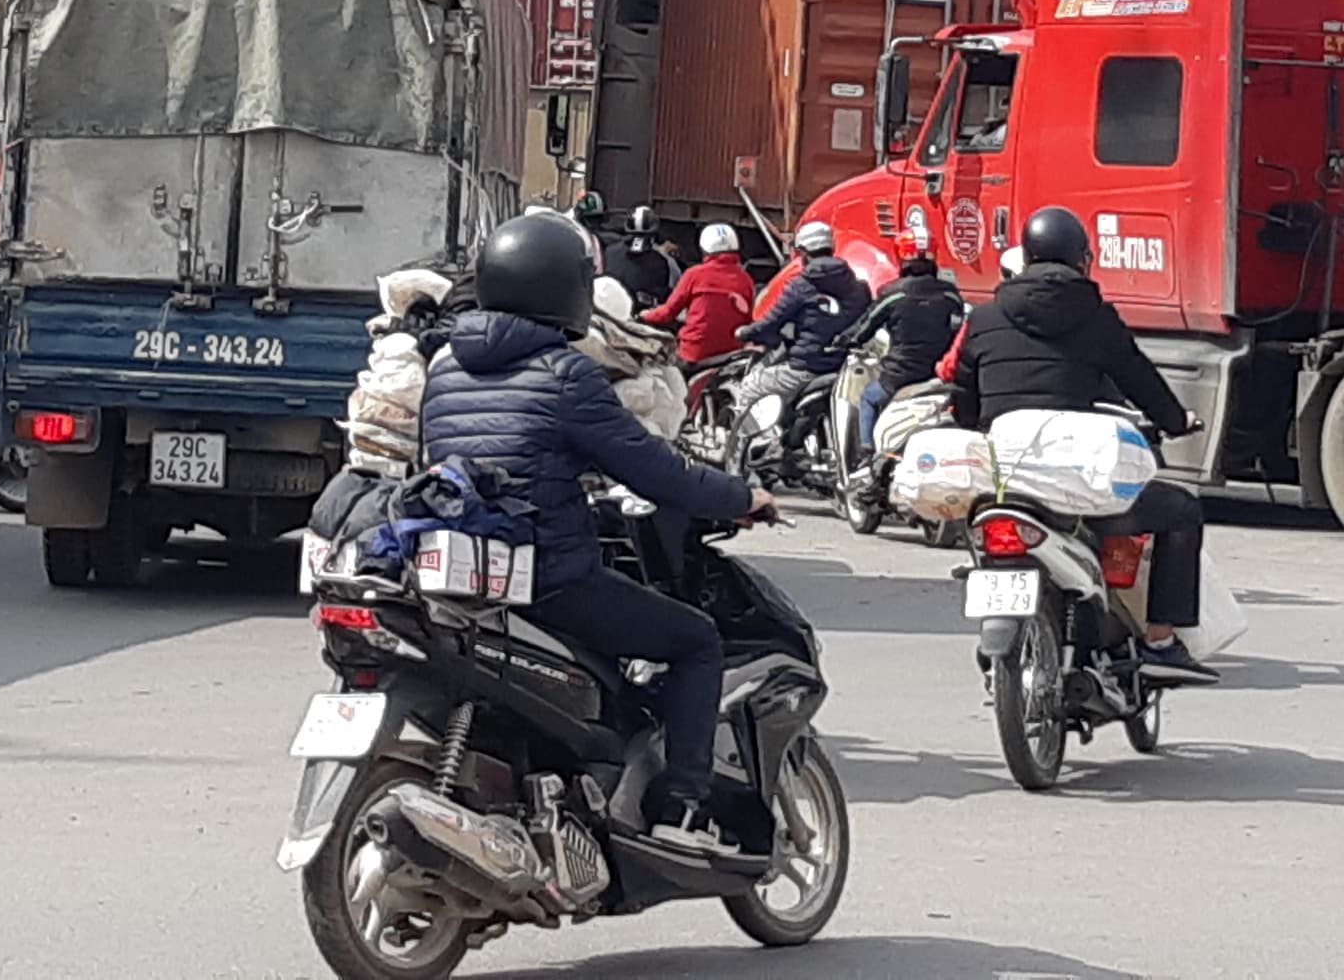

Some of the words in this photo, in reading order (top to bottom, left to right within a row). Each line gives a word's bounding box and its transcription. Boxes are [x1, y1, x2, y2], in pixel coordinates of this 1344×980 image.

[133, 330, 180, 359] 29C
[203, 334, 284, 366] 343.24
[169, 436, 207, 459] 29C
[153, 459, 220, 484] 343.24
